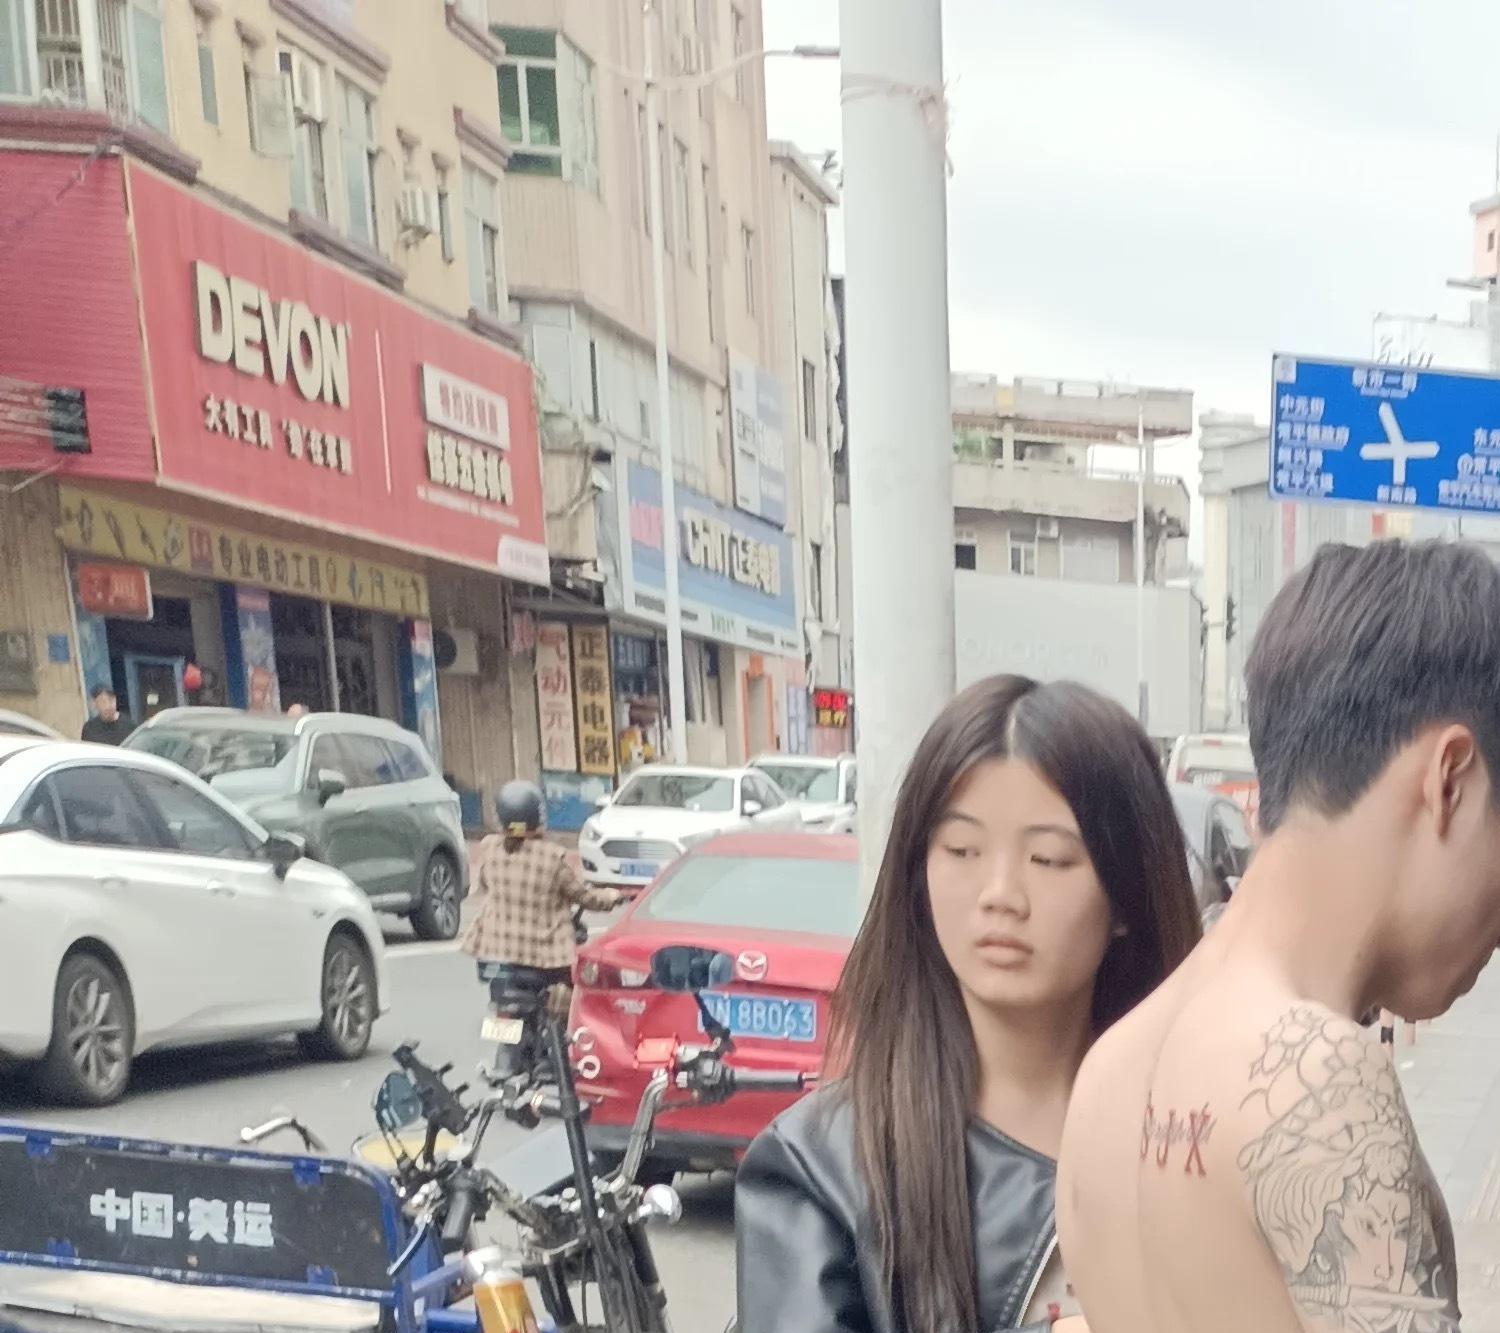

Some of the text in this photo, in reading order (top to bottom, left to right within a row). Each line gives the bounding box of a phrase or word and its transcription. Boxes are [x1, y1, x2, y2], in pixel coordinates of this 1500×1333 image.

[195, 258, 350, 411] DEVON
[578, 628, 612, 767] 正泰电器
